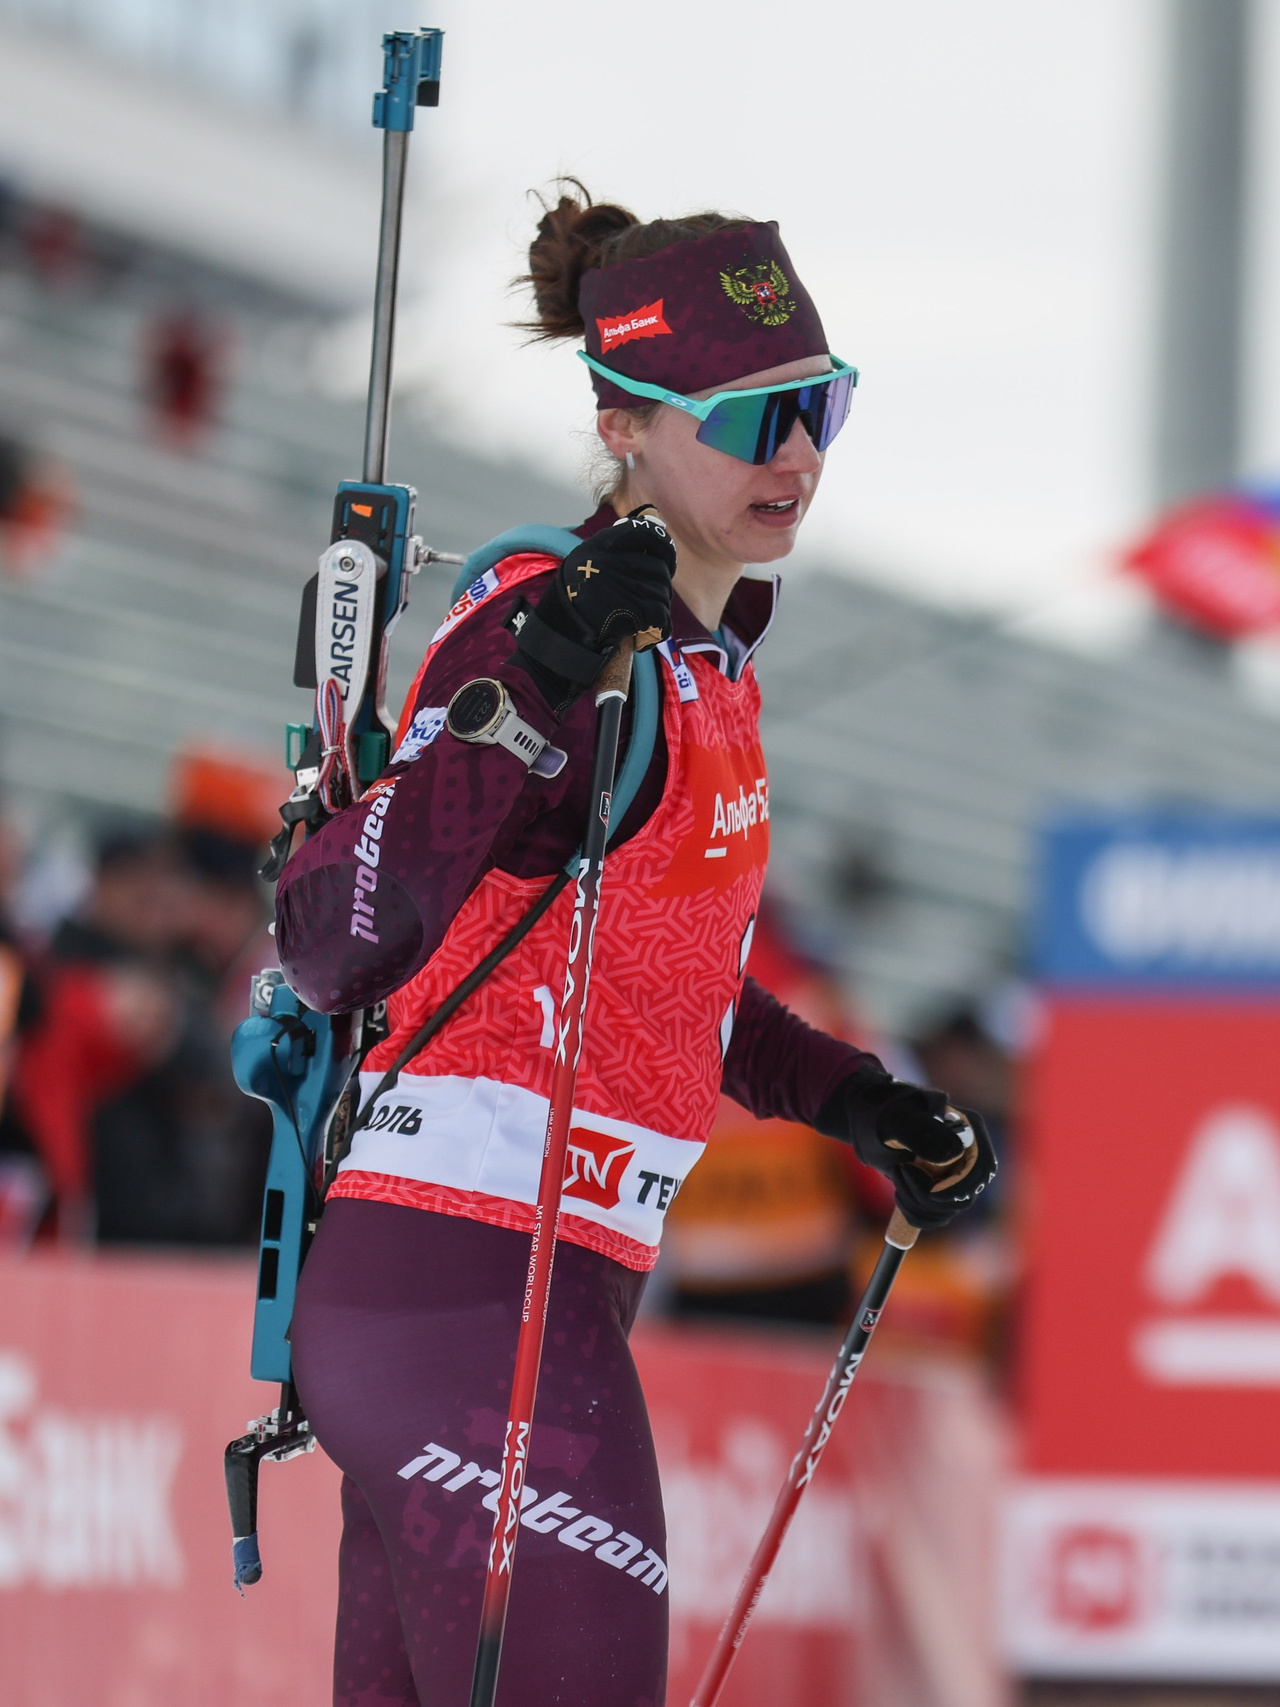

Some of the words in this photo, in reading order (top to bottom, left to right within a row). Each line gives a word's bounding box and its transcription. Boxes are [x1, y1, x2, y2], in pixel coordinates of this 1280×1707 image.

[603, 323, 632, 338] Альфа
[631, 315, 659, 330] Банк
[330, 581, 359, 702] LARSEN
[710, 786, 757, 841] Альфа
[553, 858, 591, 1070] MOAX
[530, 1222, 542, 1252] STAR
[796, 1352, 864, 1490] MOAX
